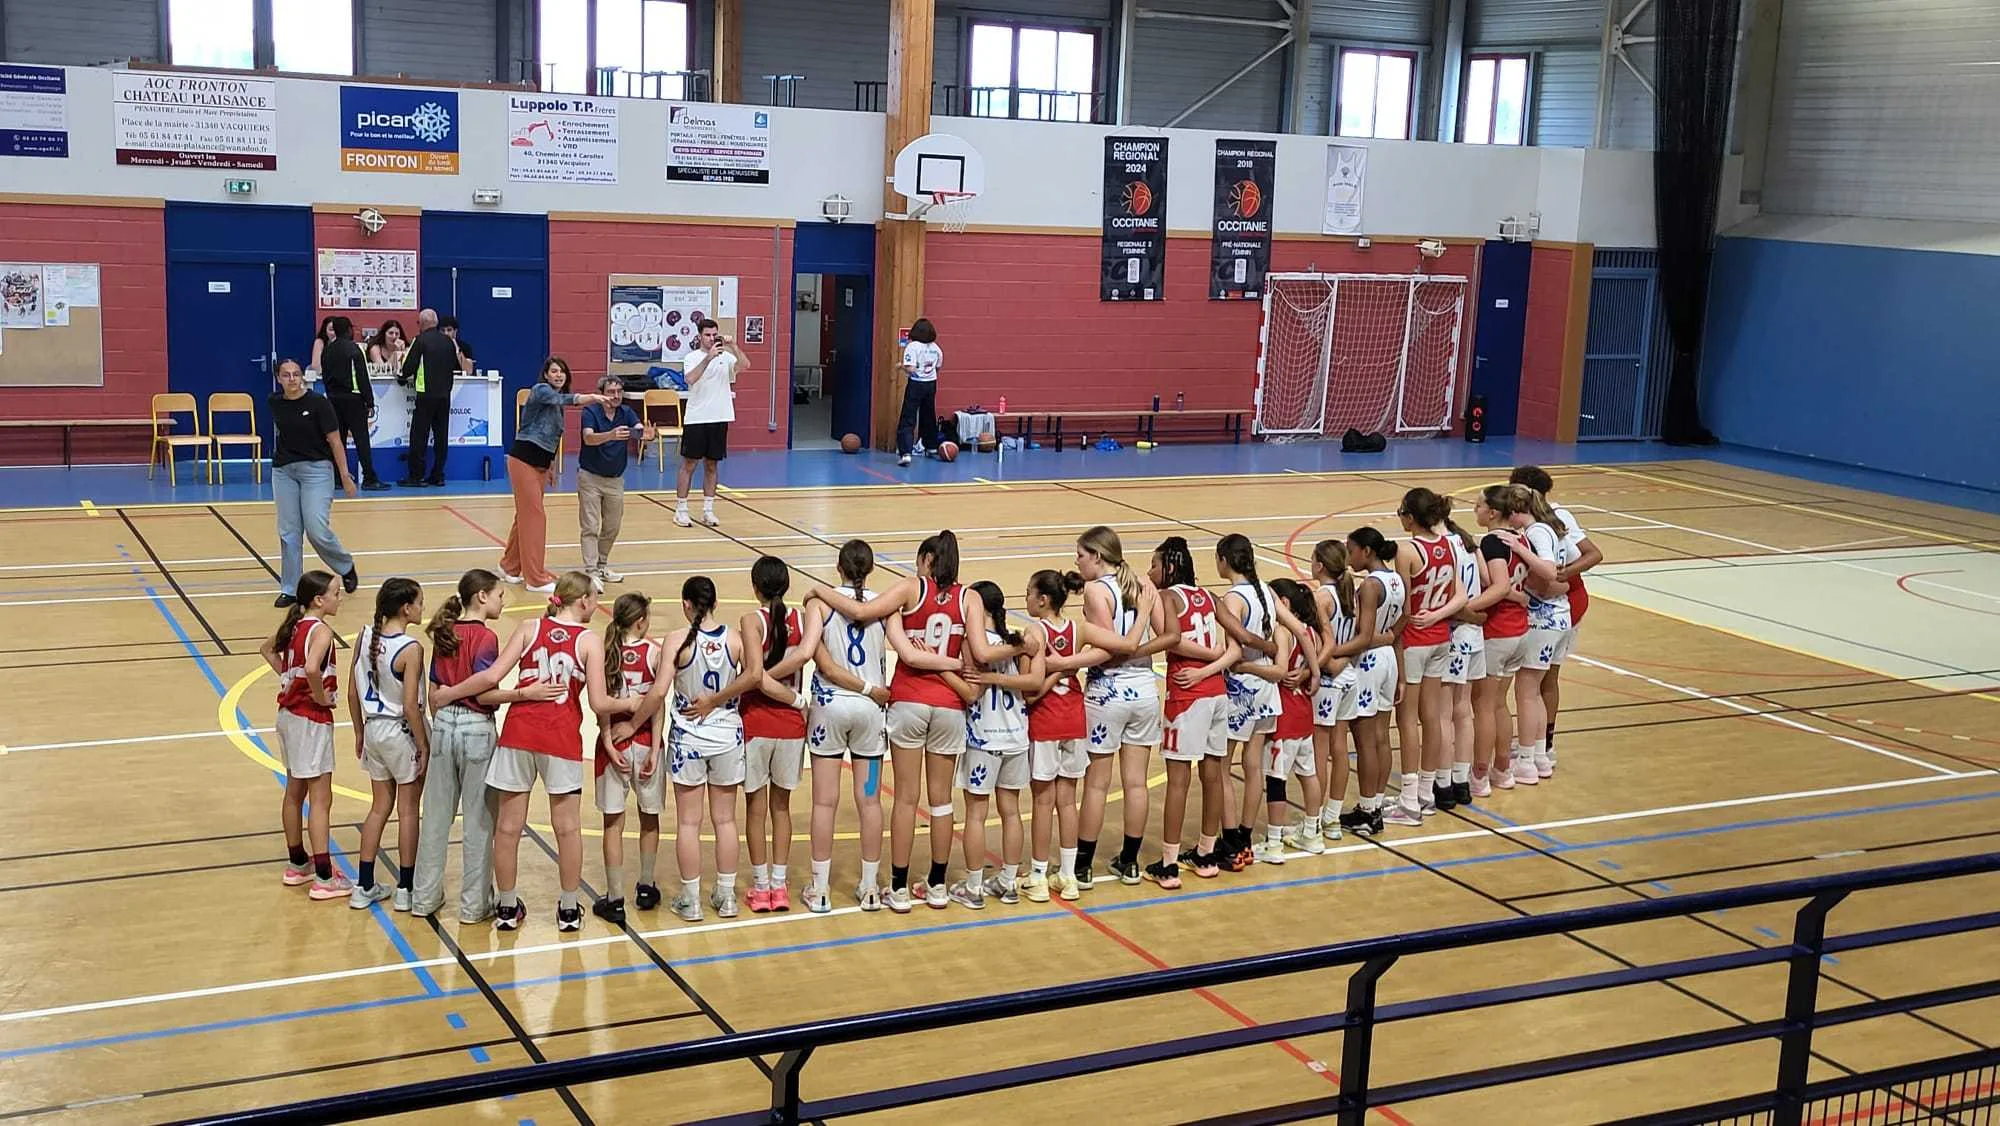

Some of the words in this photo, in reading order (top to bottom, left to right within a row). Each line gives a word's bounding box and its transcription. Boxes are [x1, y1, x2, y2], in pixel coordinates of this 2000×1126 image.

[144, 77, 174, 89] AOC
[179, 79, 248, 93] FRONTON
[124, 90, 187, 103] CHATEAU
[192, 93, 266, 107] PLAISANCE
[511, 97, 568, 113] Luppolo
[573, 101, 594, 112] T.P.
[121, 117, 143, 126] Place
[144, 118, 152, 126] de
[155, 119, 162, 127] la
[164, 120, 188, 128] mairie
[220, 122, 270, 132] VACQUIERS
[357, 110, 428, 129] picard
[562, 120, 609, 128] Enrochement
[683, 115, 716, 126] Delmas
[562, 128, 610, 136] Terrassement
[562, 136, 616, 144] Assainissement
[1113, 142, 1160, 152] CHAMPION
[179, 152, 204, 160] Ouvert
[1113, 151, 1159, 161] REGIONAL
[1217, 149, 1246, 157] CHAMPION
[130, 156, 164, 165] Mercredi
[171, 158, 191, 166] Jeudi
[236, 161, 264, 169] Samedi
[346, 153, 417, 169] FRONTON
[1125, 163, 1147, 173] 2024
[1112, 217, 1159, 228] OCCITANIE
[1218, 220, 1267, 231] OCCITANIE
[1422, 564, 1454, 610] 12
[925, 612, 951, 658] 9
[1190, 611, 1216, 650] 11
[847, 622, 866, 667] 8
[532, 645, 575, 705] 10
[365, 670, 385, 712] 4
[1163, 727, 1179, 753] 11
[1270, 747, 1280, 770] 7
